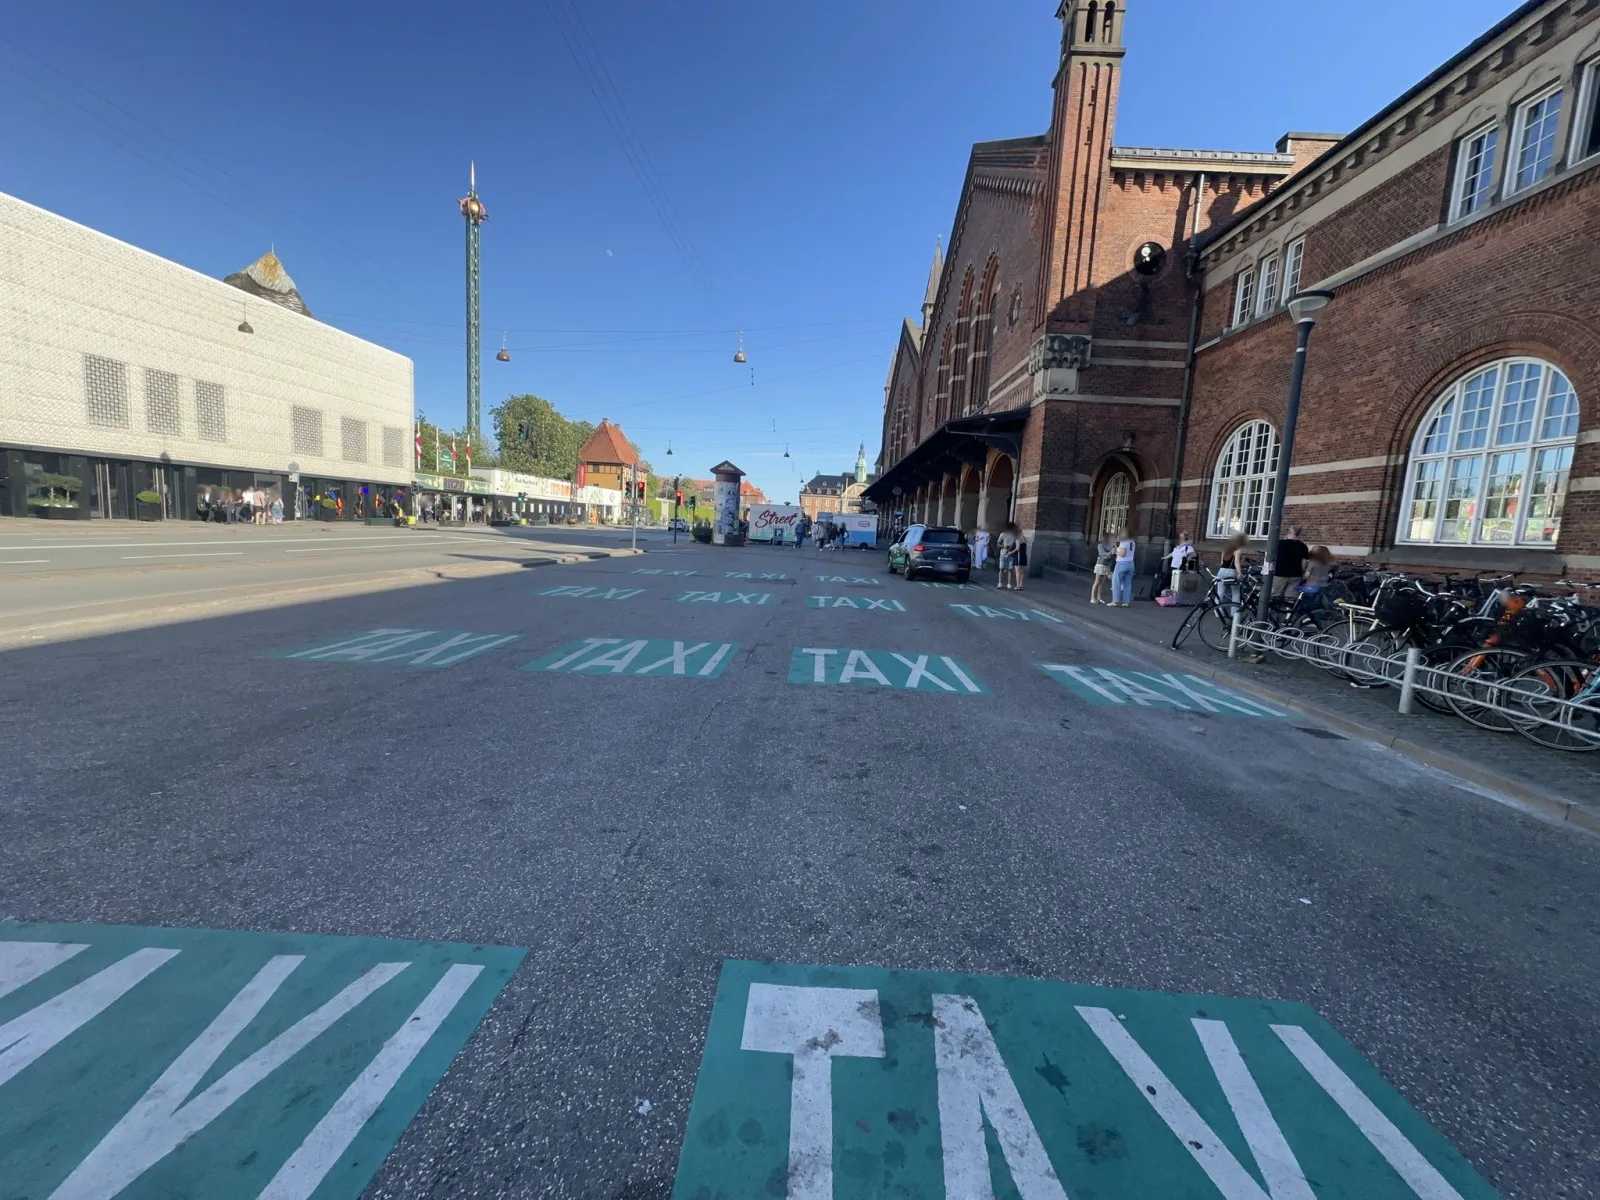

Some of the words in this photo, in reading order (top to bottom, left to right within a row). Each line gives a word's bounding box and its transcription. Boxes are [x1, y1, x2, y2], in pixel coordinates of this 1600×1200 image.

[755, 509, 798, 529] Street
[631, 568, 698, 576] TAXI
[723, 571, 787, 580] TAXI
[815, 575, 880, 585] TAXI
[538, 585, 646, 600] TAXI
[677, 591, 771, 605] TAXI
[811, 595, 907, 612] TAXI
[284, 628, 520, 665] TAXI
[545, 637, 733, 676] TAXI
[801, 648, 982, 693] TAXI
[1042, 664, 1288, 717] TAXI
